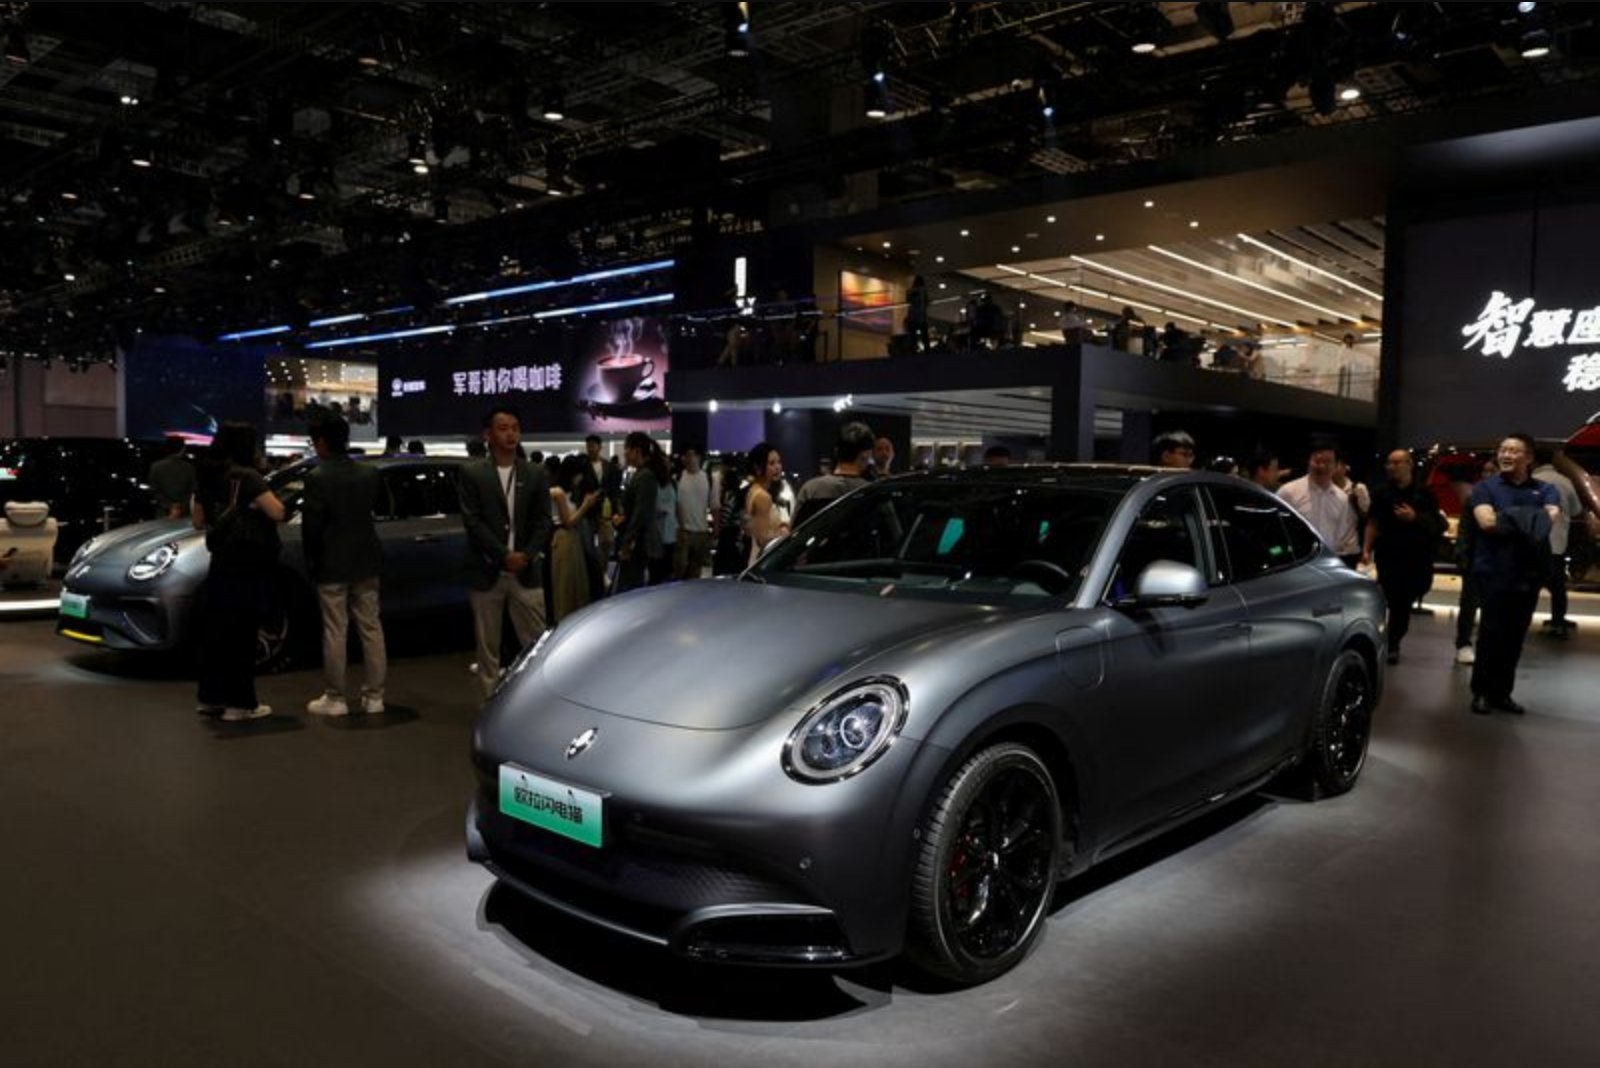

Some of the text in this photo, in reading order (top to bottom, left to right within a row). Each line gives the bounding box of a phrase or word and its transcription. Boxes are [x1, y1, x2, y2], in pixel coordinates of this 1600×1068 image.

[452, 362, 562, 396] 军哥请你喝咖啡
[513, 786, 584, 825] 欧拉闪电猫
